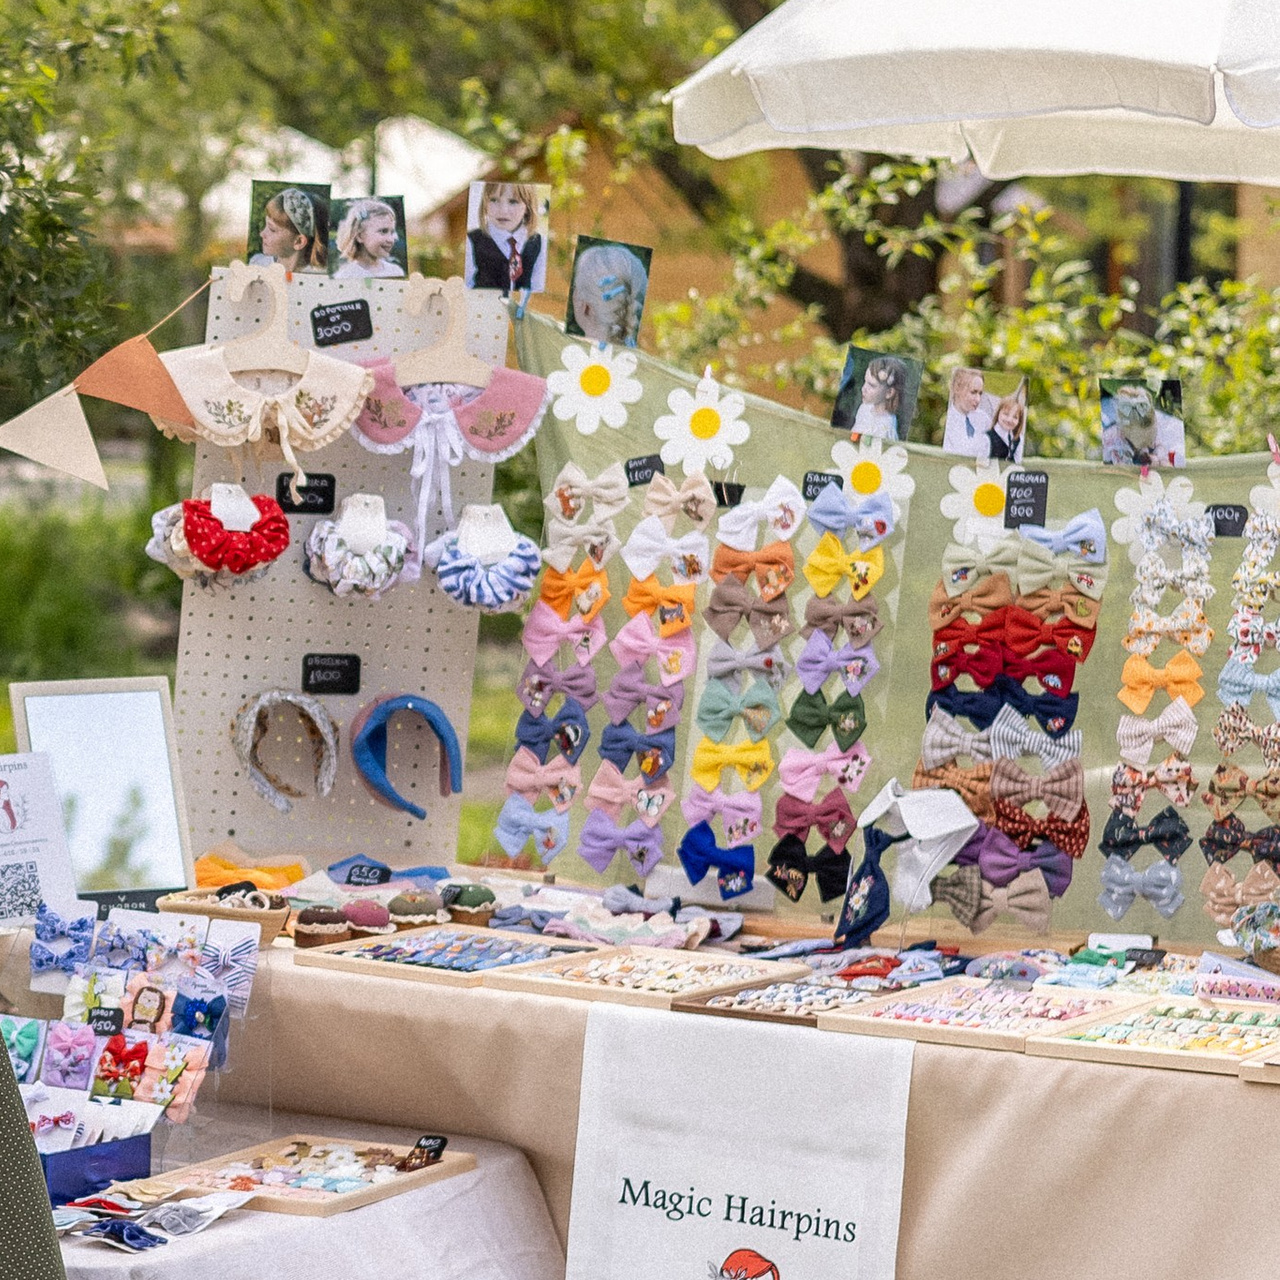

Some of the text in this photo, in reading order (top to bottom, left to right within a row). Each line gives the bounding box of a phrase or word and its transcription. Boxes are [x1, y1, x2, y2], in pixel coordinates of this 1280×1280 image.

[316, 321, 352, 340] 3000
[805, 484, 824, 497] 80
[1009, 486, 1033, 499] 700
[1010, 504, 1034, 518] 900
[351, 866, 380, 878] 650
[618, 1177, 858, 1243] Magic Hairpins
